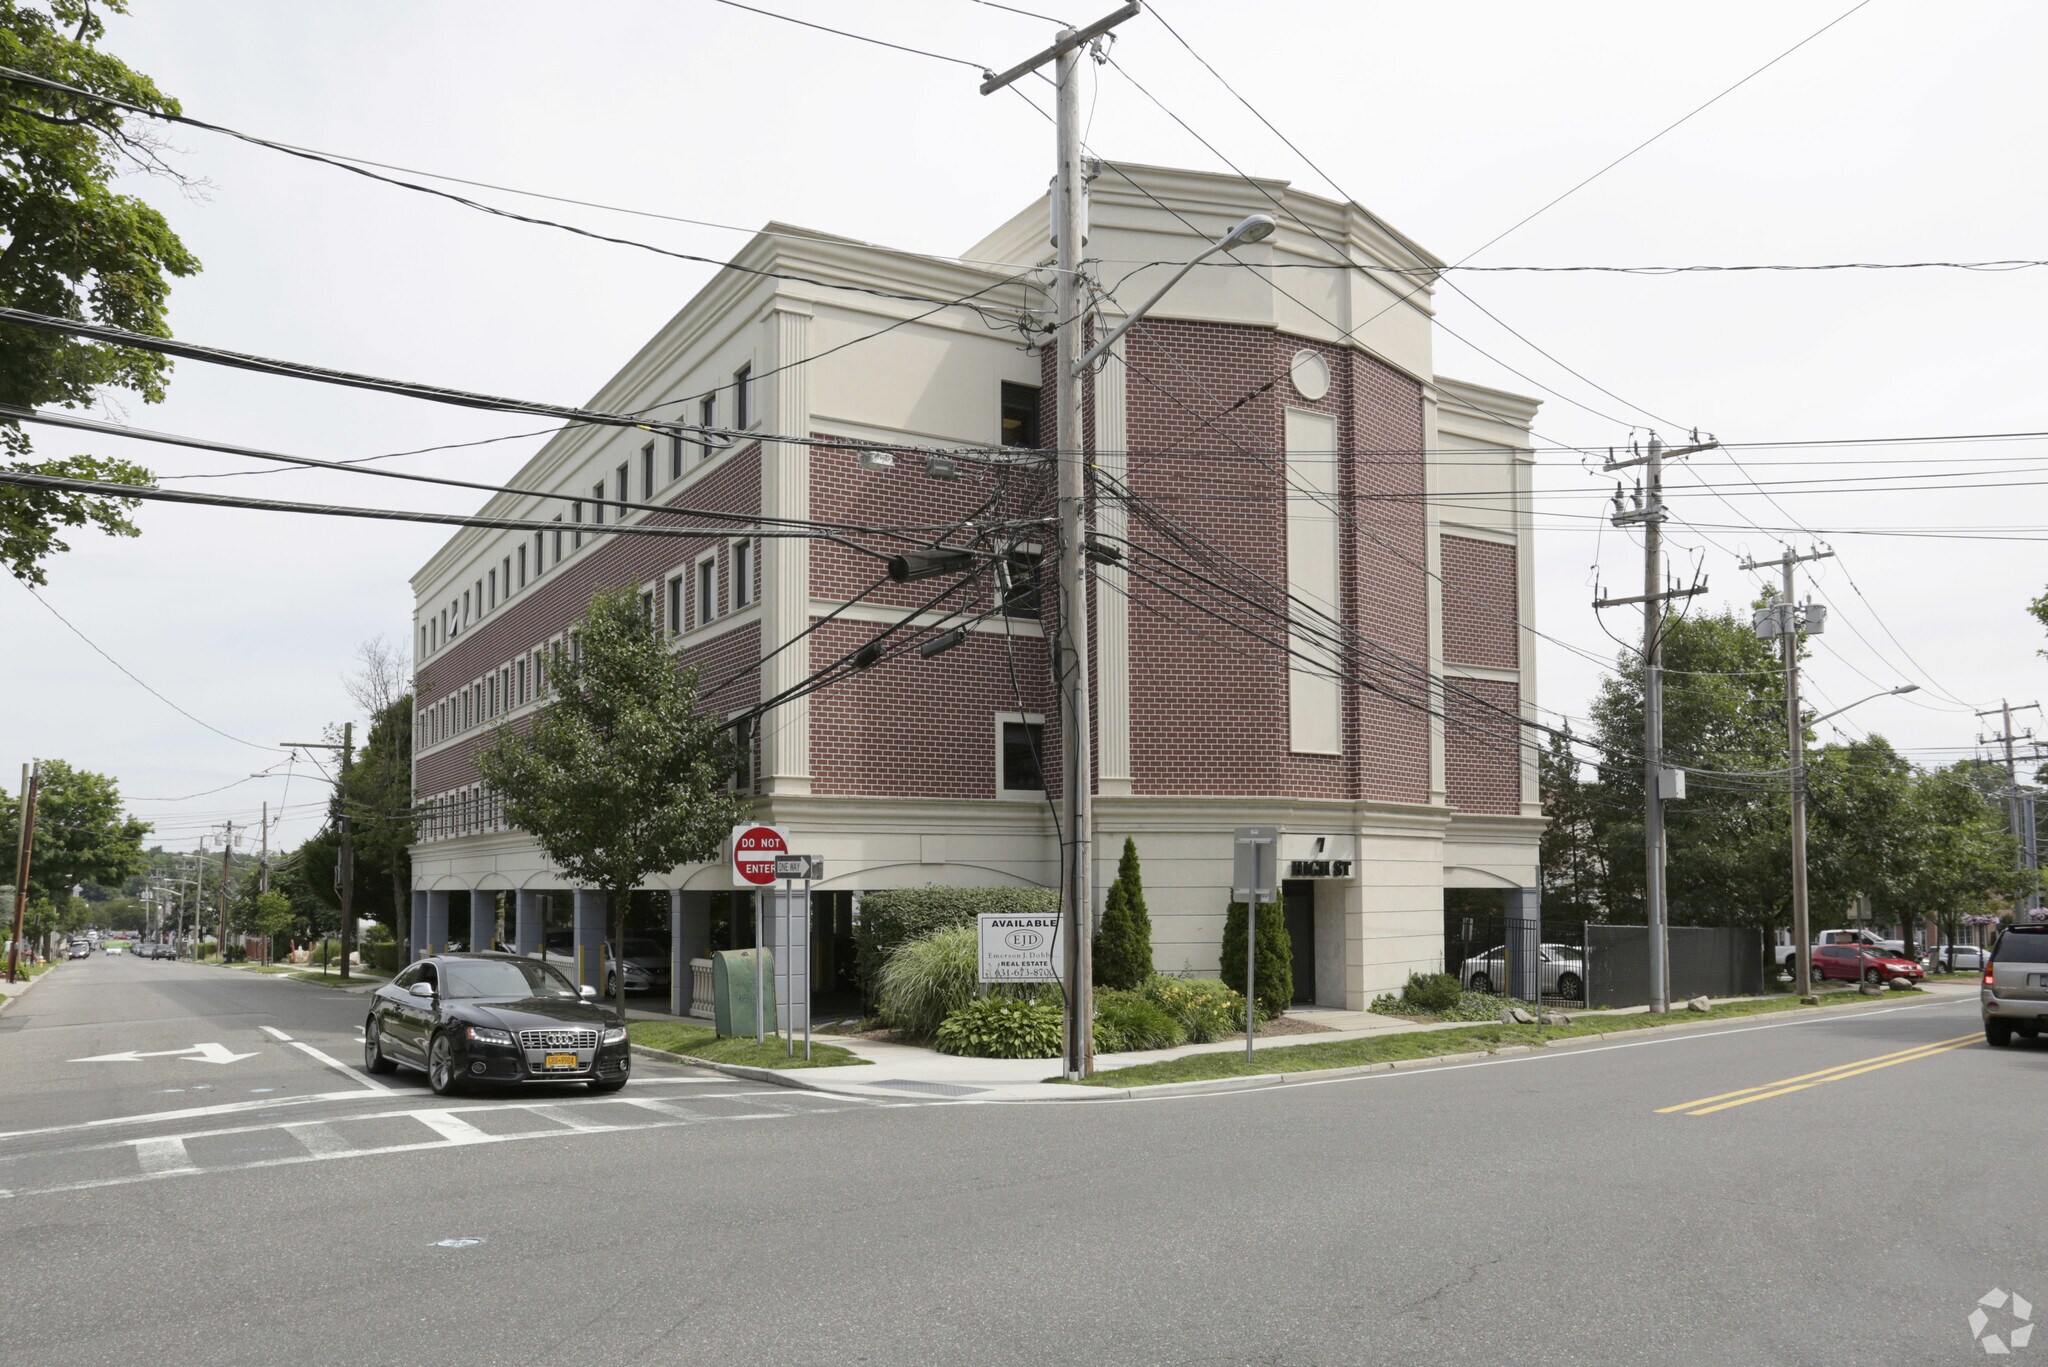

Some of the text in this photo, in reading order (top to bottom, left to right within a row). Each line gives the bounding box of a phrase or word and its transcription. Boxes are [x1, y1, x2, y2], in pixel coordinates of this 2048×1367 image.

[742, 838, 780, 848] DO NOT
[1316, 837, 1326, 853] 7
[746, 864, 775, 874] ENTER
[778, 861, 800, 872] ONE WAY
[1333, 860, 1352, 876] ST
[1013, 934, 1038, 946] EJD
